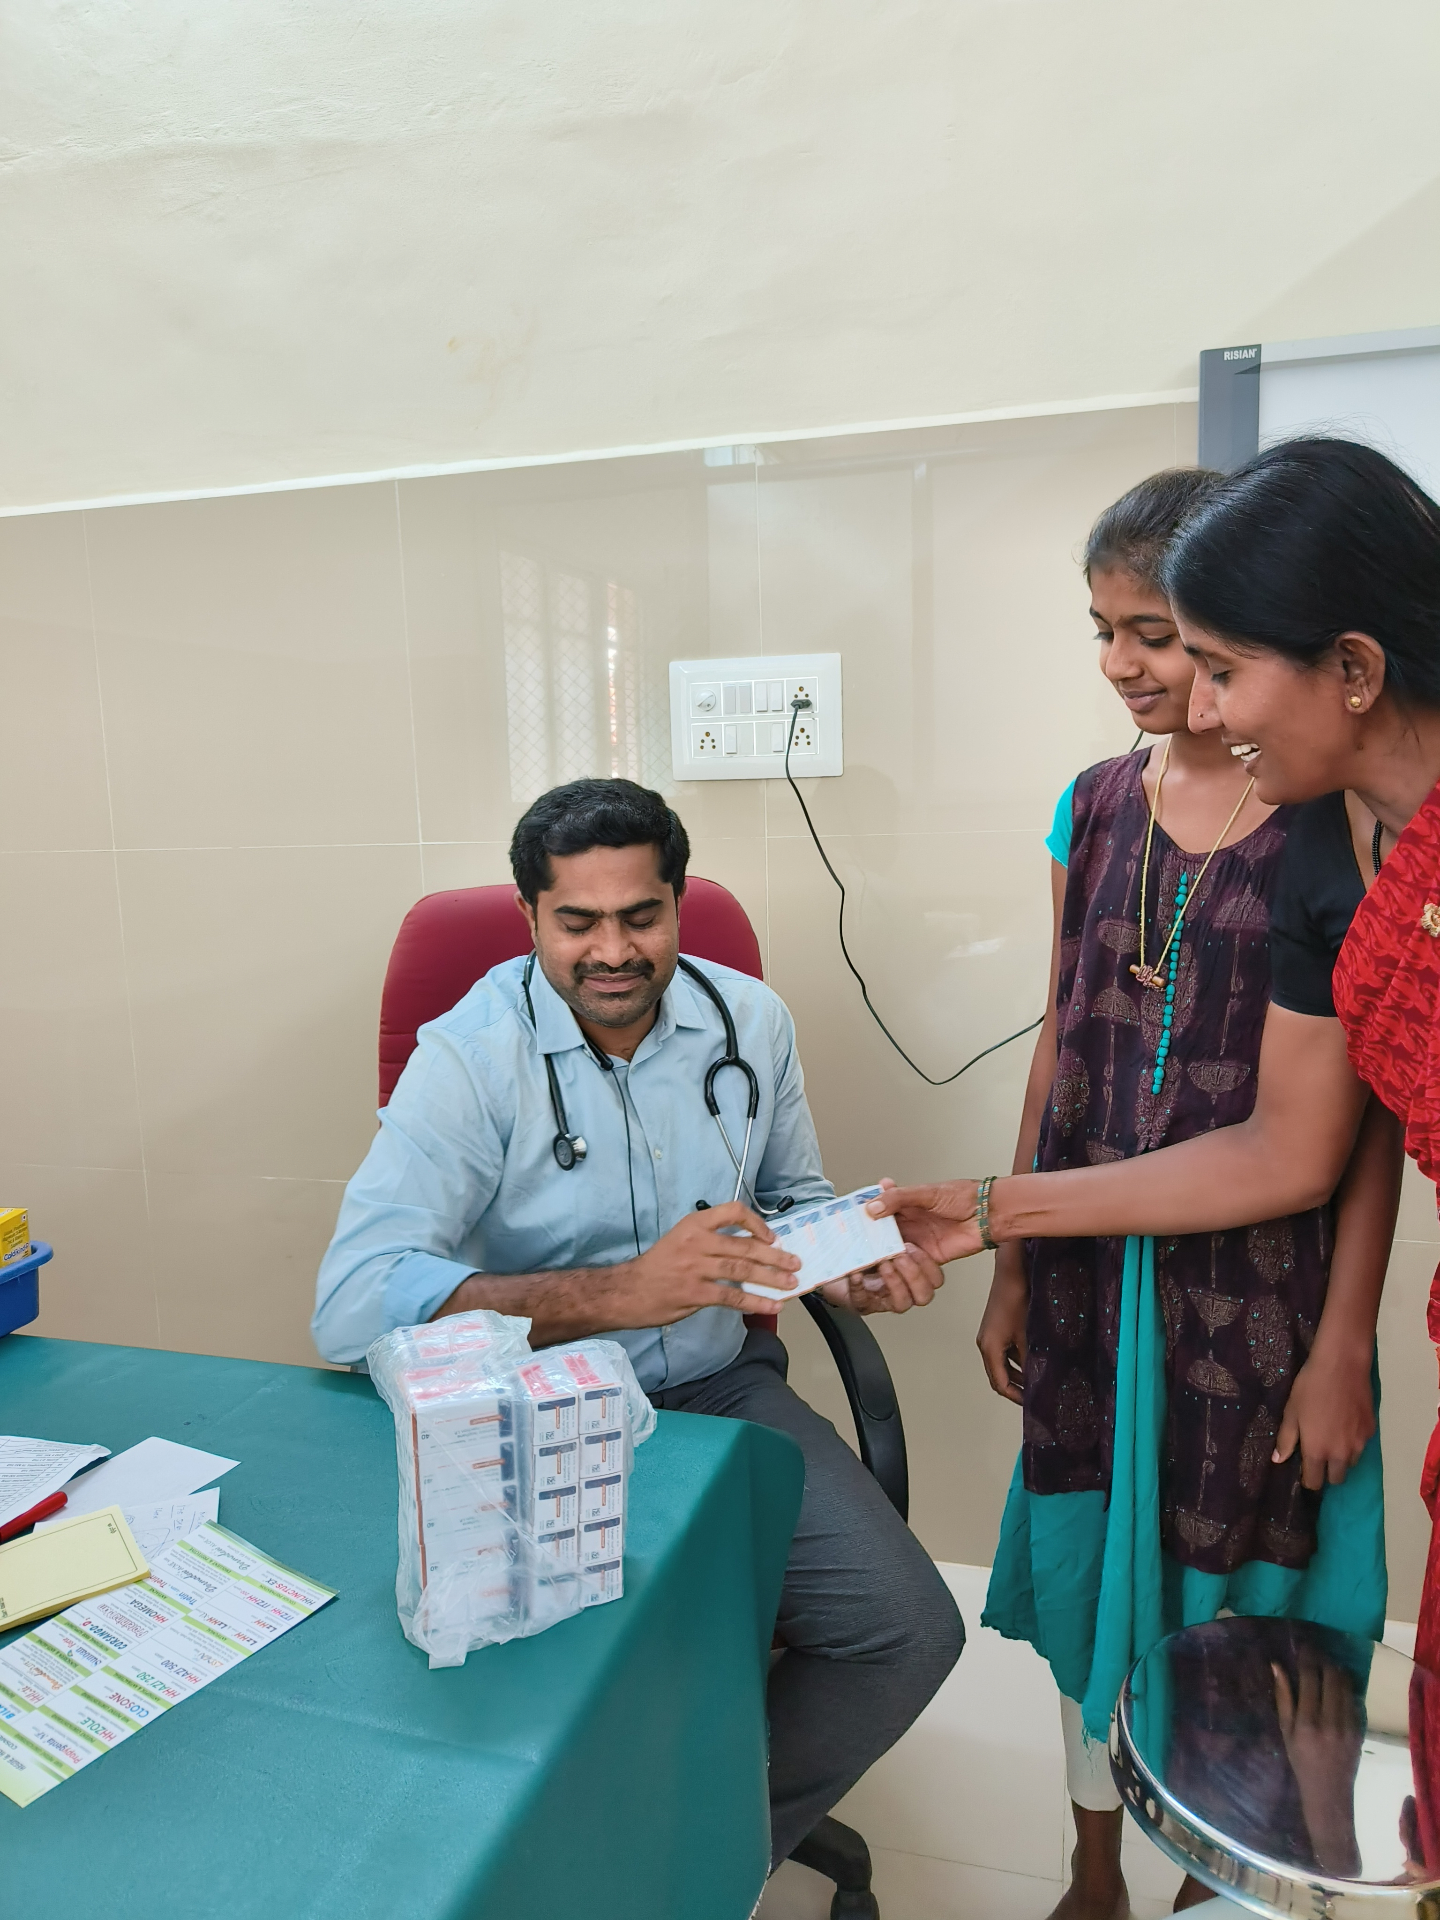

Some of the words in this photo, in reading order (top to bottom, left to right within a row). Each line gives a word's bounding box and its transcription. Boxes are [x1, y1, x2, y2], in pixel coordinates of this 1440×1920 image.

[1223, 349, 1255, 361] RISIAN
[175, 1591, 198, 1605] Tretin
[128, 1598, 168, 1623] HHOMEGA
[73, 1646, 102, 1666] Sunban
[159, 1658, 178, 1670] 500
[135, 1671, 155, 1683] 250
[173, 1666, 202, 1684] HHAZI
[149, 1679, 180, 1699] HHAZI
[107, 1691, 150, 1718] CLOSONE
[78, 1716, 117, 1741] HHZOLE
[44, 1737, 83, 1764] Propygenta
